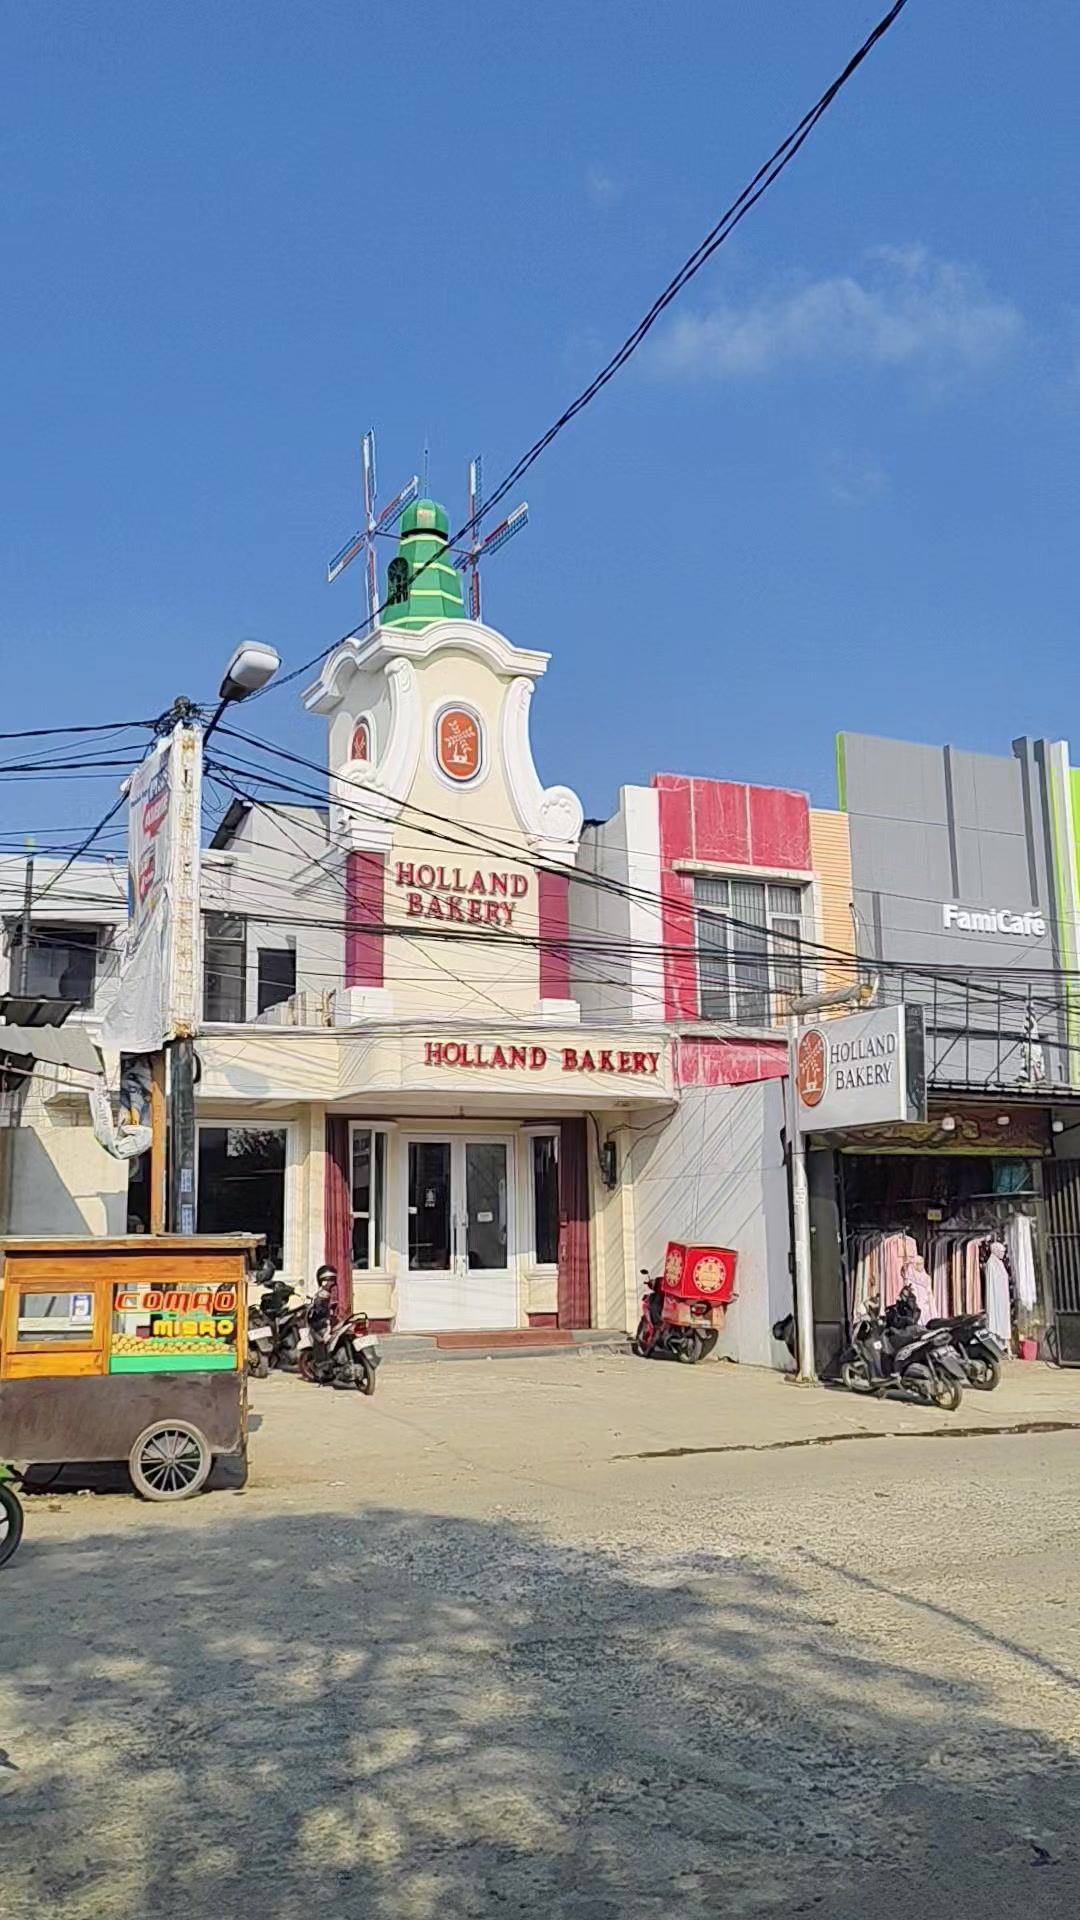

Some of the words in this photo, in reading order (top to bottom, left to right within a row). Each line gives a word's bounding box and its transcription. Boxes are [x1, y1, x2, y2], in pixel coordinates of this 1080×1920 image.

[396, 861, 529, 898] HOLLAND
[406, 892, 516, 926] BAKERY
[943, 903, 1046, 937] FamiCafé
[424, 1042, 547, 1070] HOLLAND
[561, 1048, 661, 1073] BAKERY
[830, 1033, 896, 1065] HOLLAND
[836, 1061, 892, 1090] BAKERY
